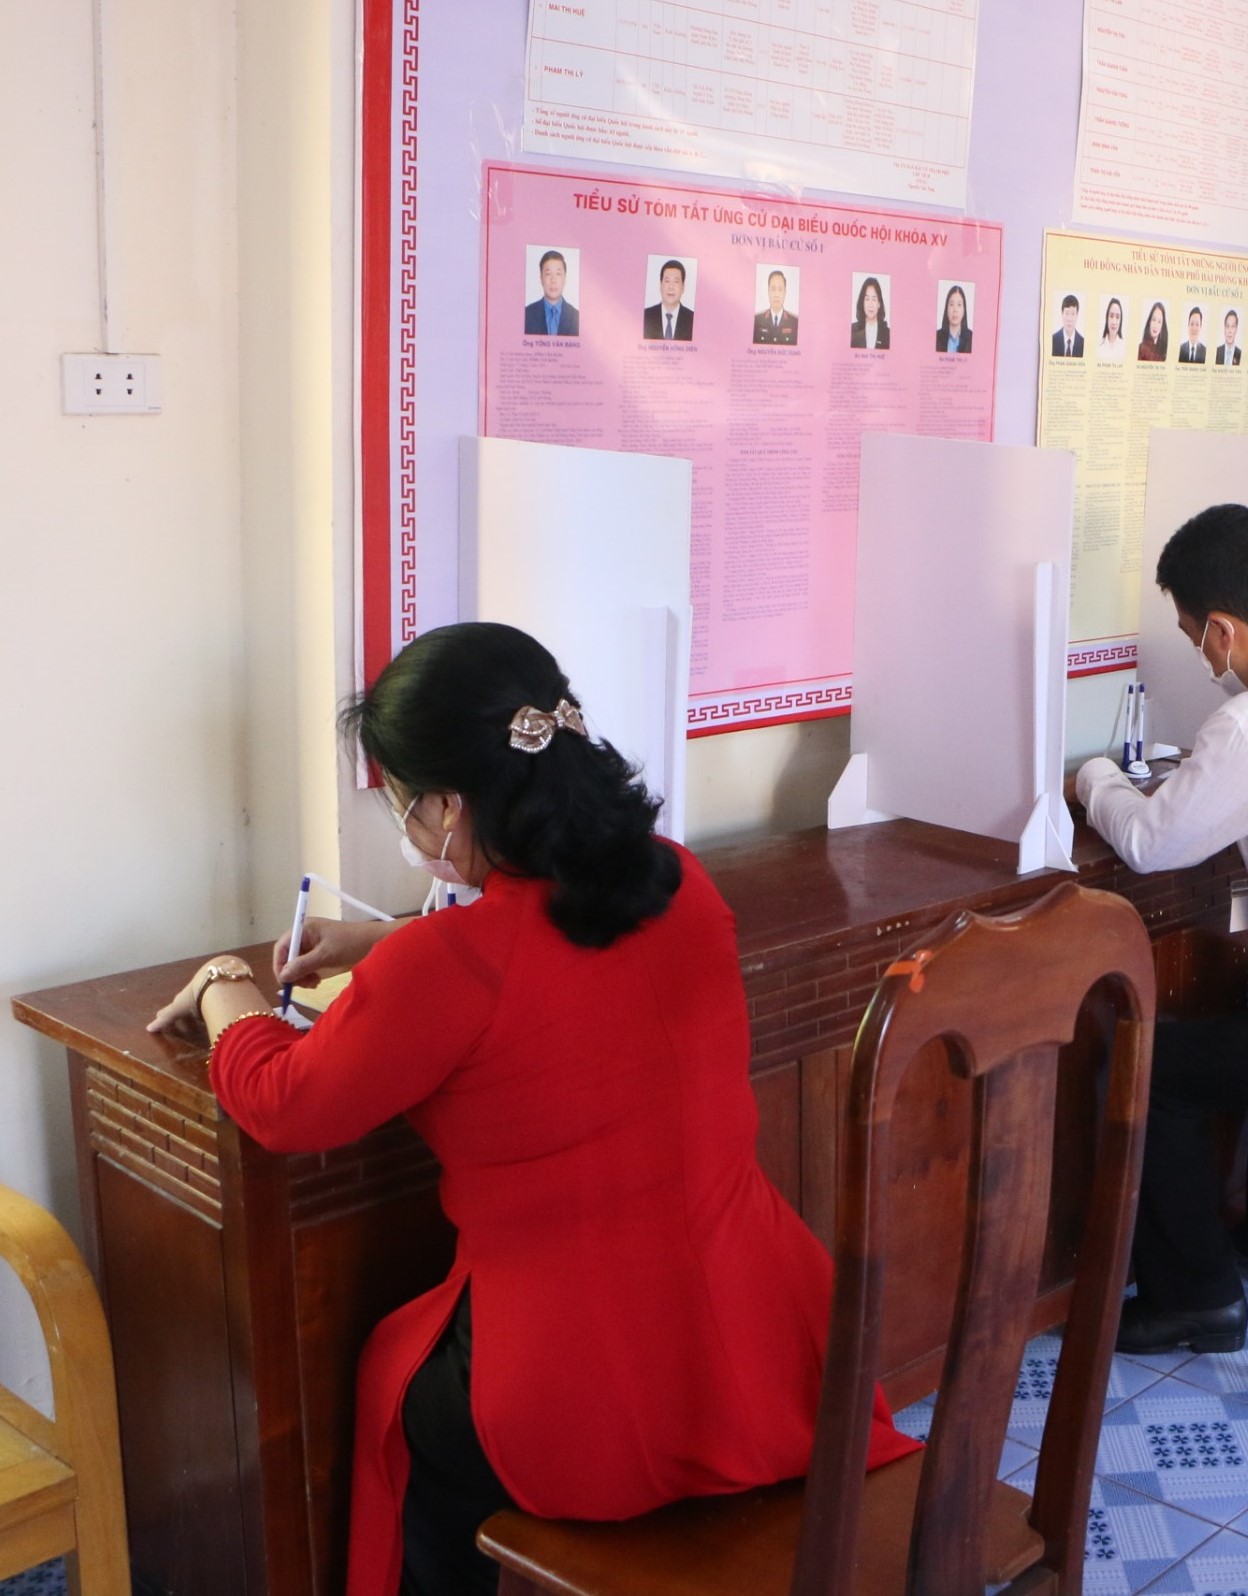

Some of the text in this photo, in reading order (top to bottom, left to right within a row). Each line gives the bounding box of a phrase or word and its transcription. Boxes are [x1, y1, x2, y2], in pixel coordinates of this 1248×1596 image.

[574, 188, 612, 212] TIỂU
[618, 194, 640, 214] SỬ
[644, 198, 676, 218] TÓM
[682, 199, 708, 221] TẮT
[713, 205, 743, 225] ỨNG
[748, 208, 767, 227] CỬ
[799, 213, 828, 234] BIỂU
[832, 218, 866, 238] QUỐC
[871, 227, 891, 245] HỘI
[895, 228, 927, 245] KHÓA
[931, 234, 948, 246] XV
